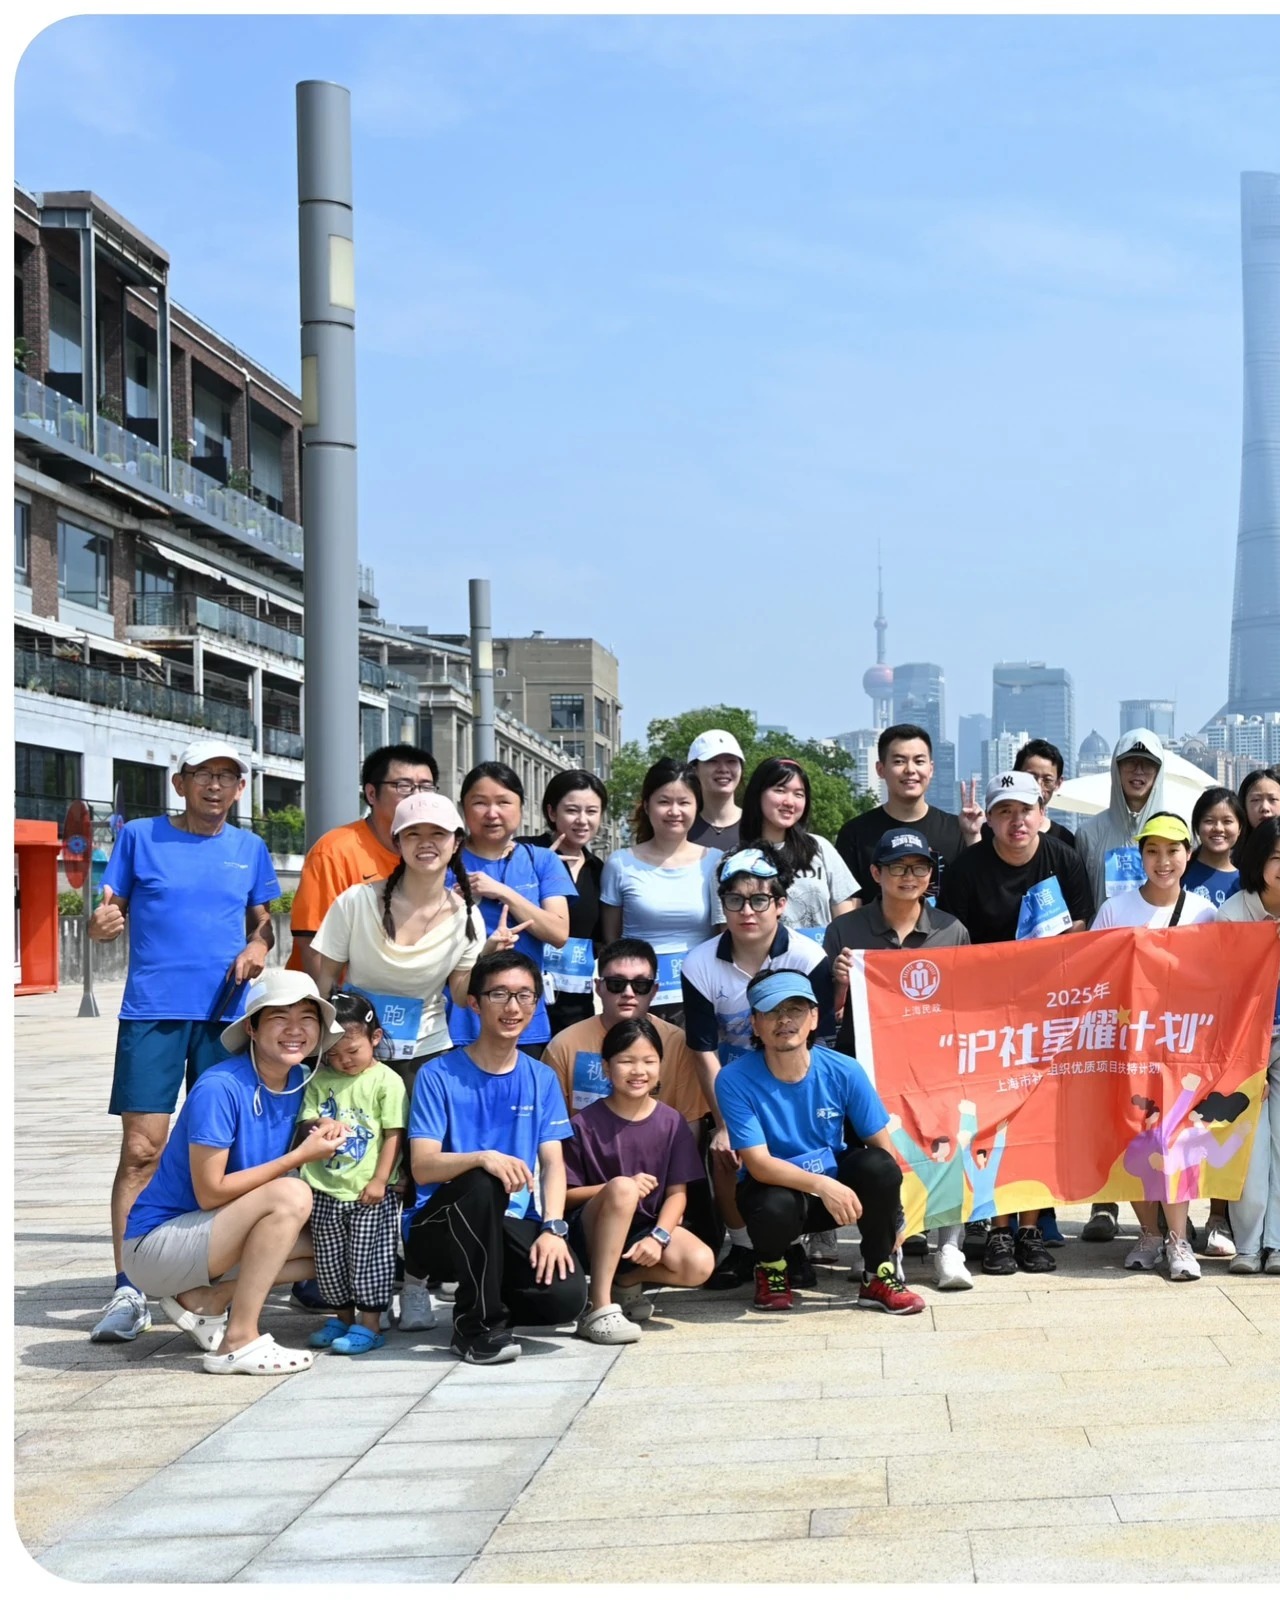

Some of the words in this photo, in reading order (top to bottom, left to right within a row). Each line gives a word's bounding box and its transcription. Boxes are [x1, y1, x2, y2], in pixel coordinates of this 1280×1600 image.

[1046, 982, 1110, 1008] 2025年
[901, 1003, 942, 1018] 上海民政
